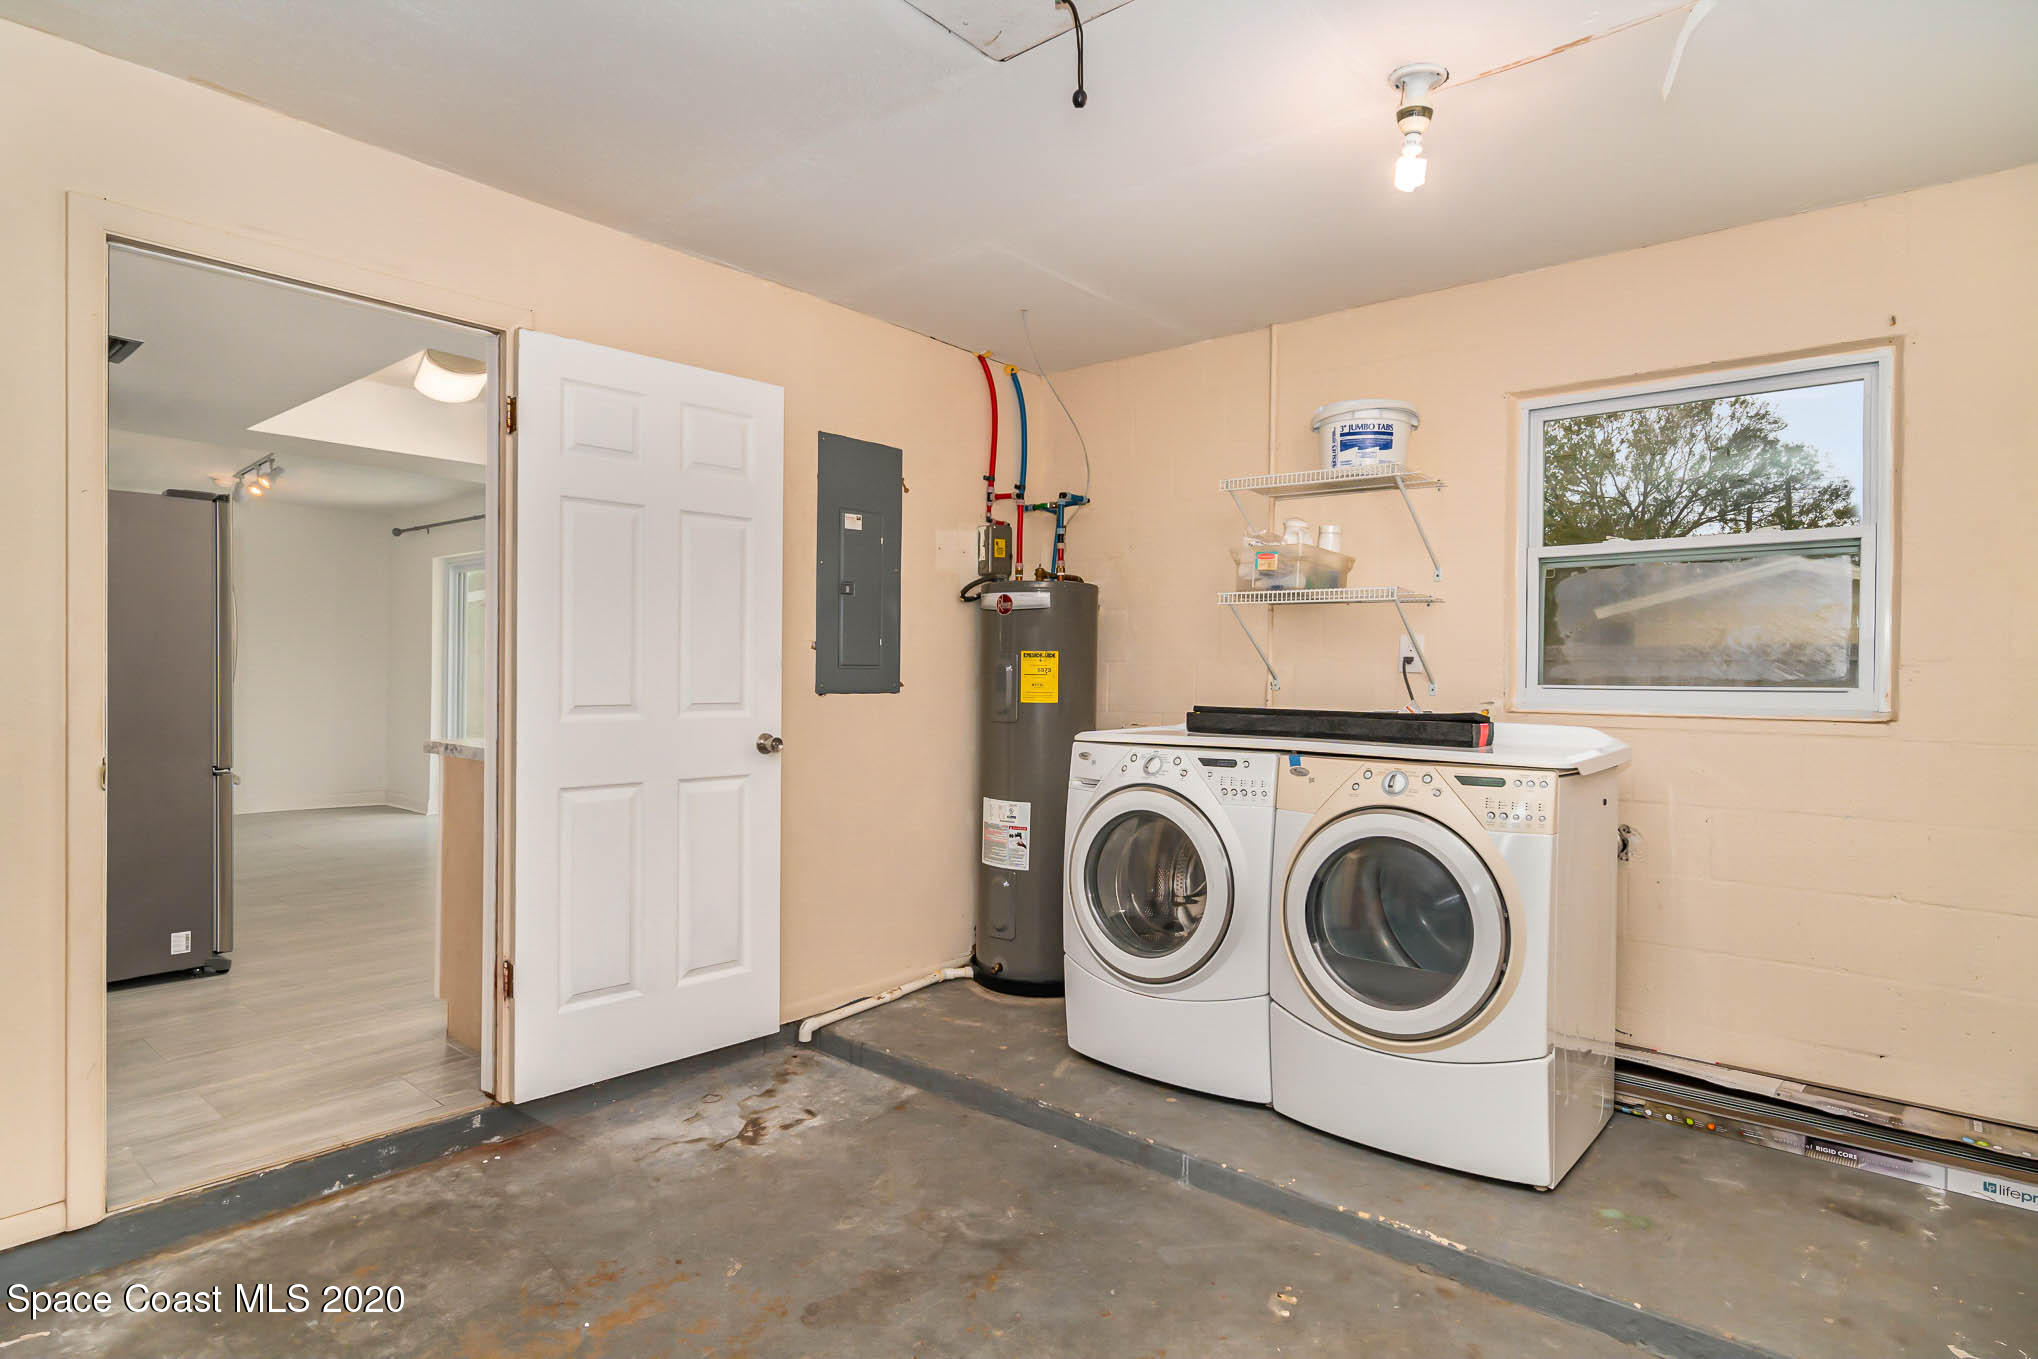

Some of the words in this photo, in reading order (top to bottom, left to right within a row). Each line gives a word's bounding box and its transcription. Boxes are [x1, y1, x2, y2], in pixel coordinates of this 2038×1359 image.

[1349, 424, 1375, 432] JUMBO
[1815, 1145, 1836, 1155] RIGID
[1837, 1150, 1857, 1160] CORE
